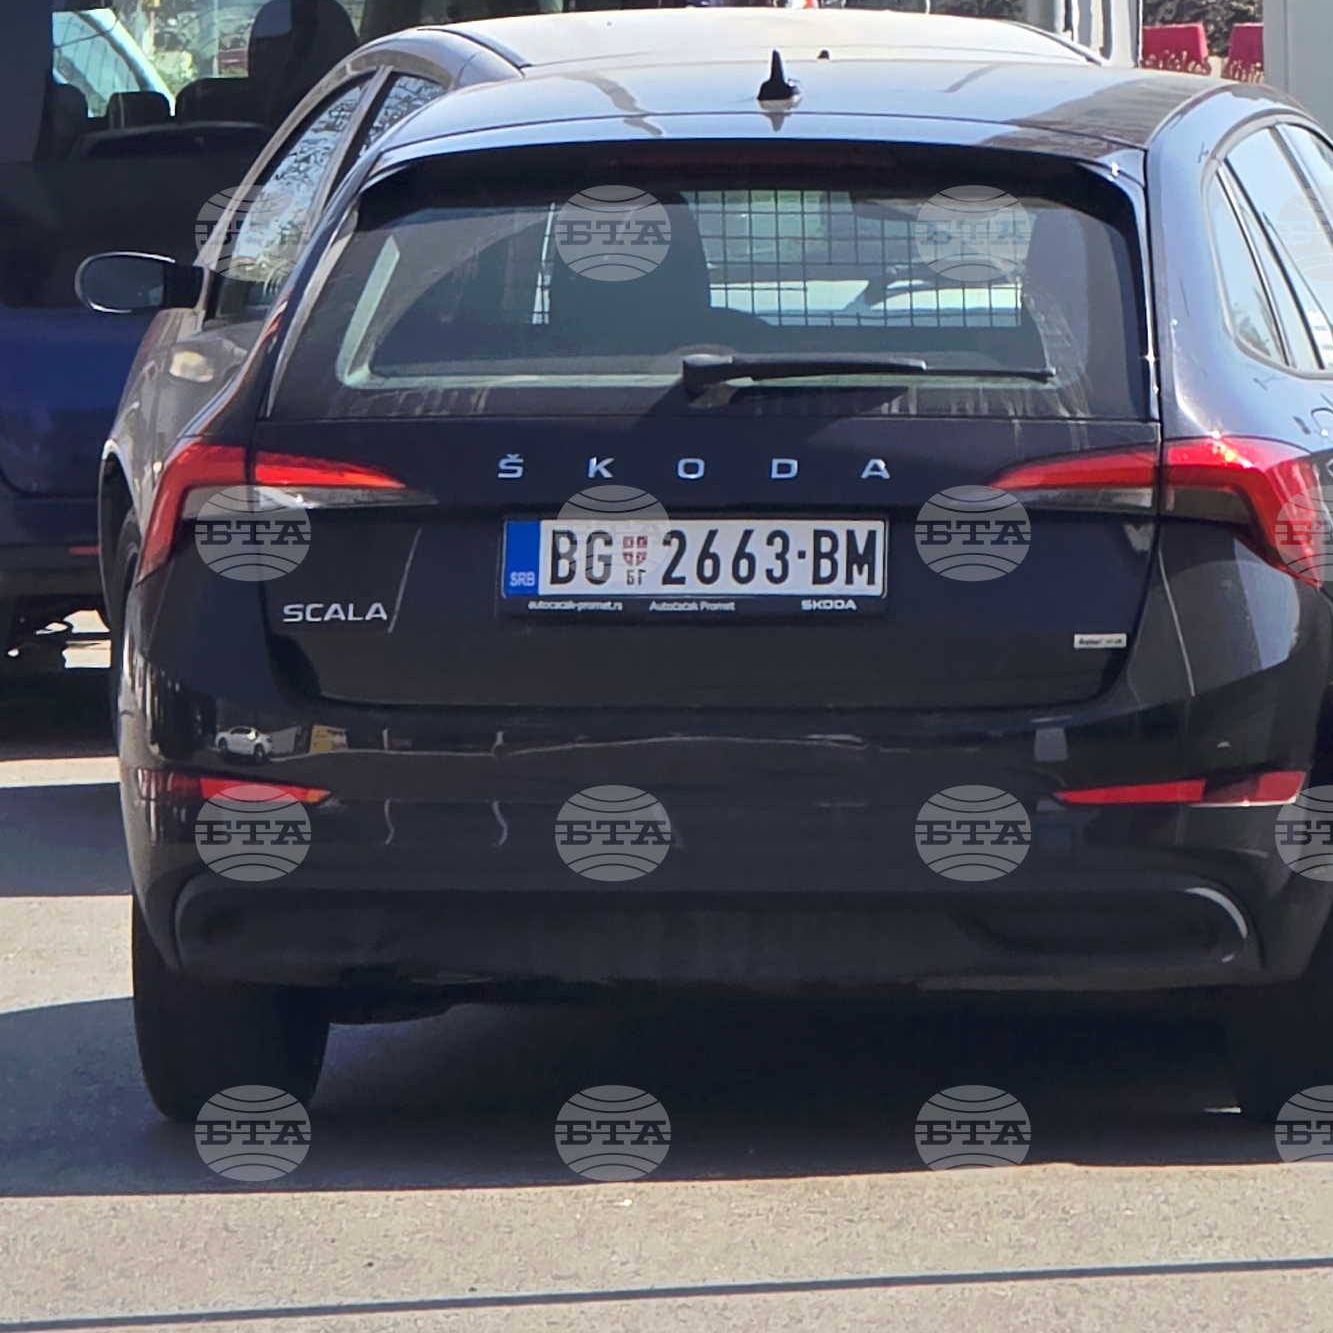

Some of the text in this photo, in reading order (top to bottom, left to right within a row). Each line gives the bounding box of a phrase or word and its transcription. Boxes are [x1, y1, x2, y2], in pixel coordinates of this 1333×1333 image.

[497, 453, 891, 479] ŠKODA
[549, 529, 613, 585] BG
[510, 571, 536, 587] SRB
[282, 601, 389, 623] SCALA
